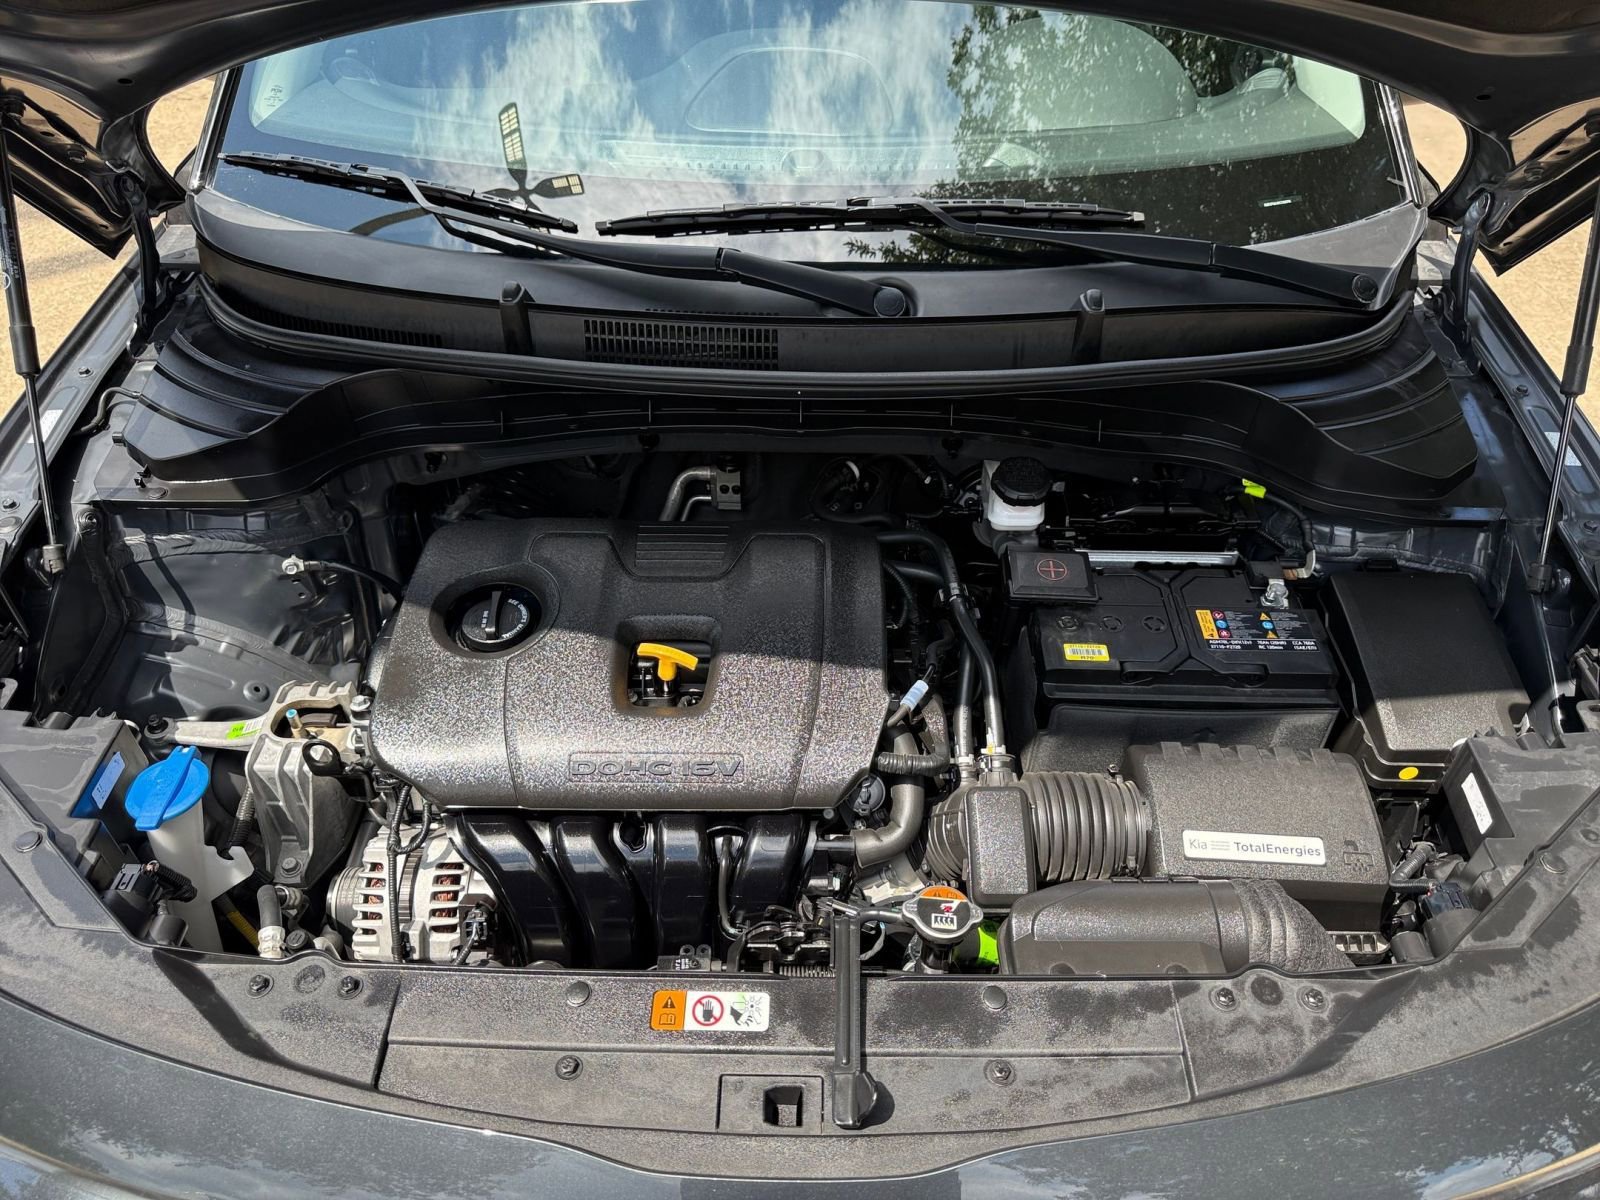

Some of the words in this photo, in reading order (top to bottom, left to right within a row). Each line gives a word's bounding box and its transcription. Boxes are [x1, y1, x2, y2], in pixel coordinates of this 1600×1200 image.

[571, 760, 673, 776] DOHC
[681, 760, 742, 777] 16V
[1188, 838, 1208, 850] Kia
[1233, 841, 1321, 857] TotalEnergies
